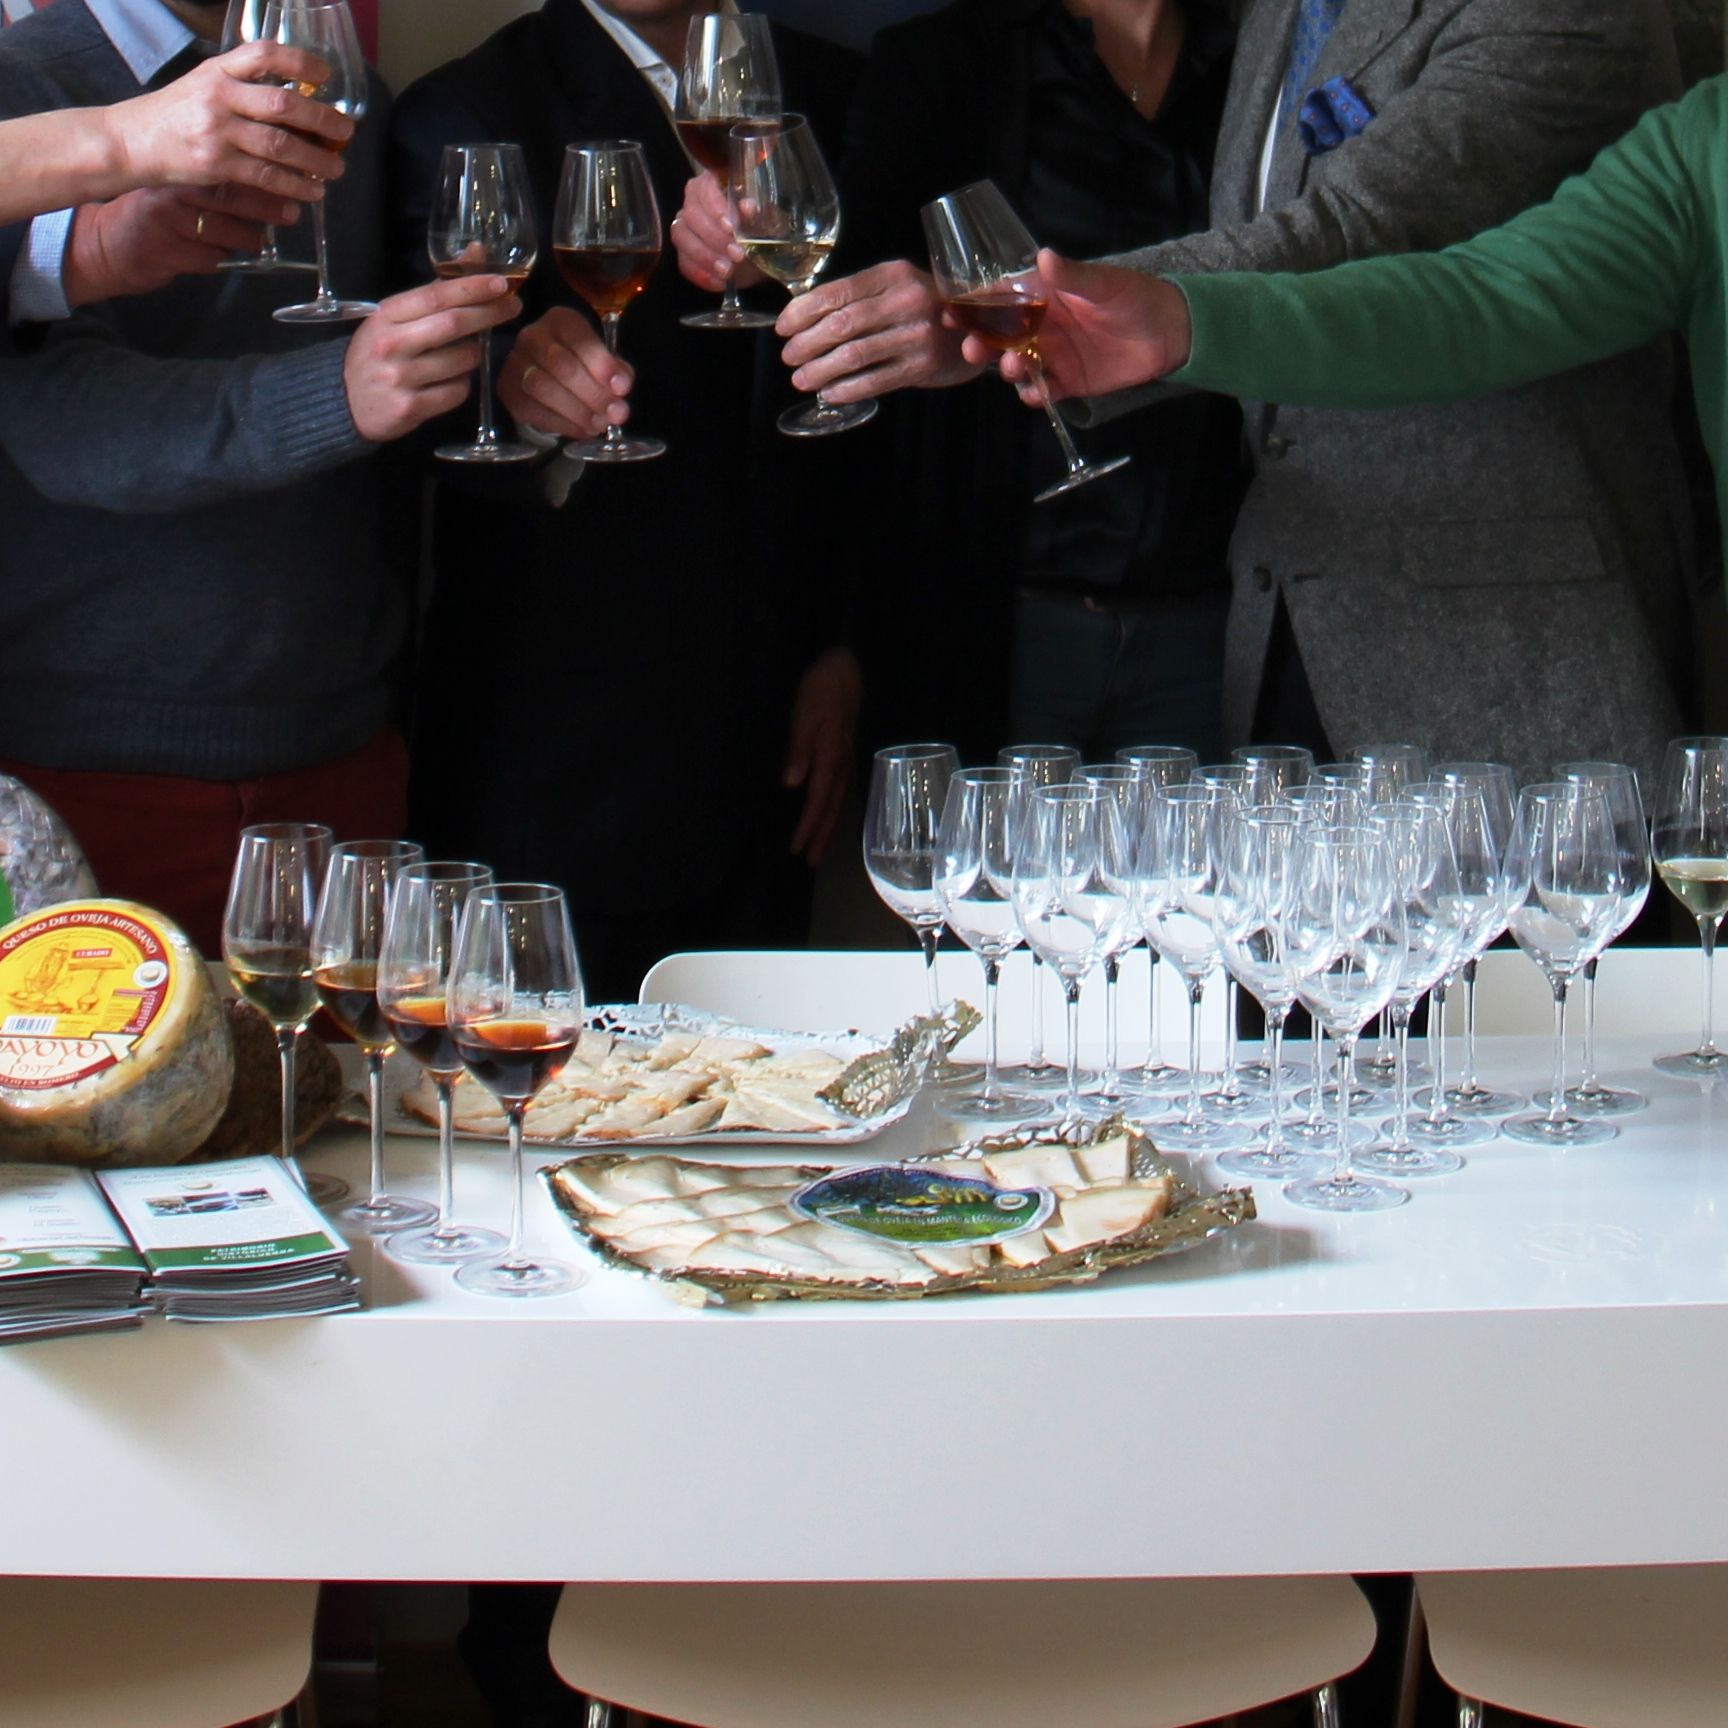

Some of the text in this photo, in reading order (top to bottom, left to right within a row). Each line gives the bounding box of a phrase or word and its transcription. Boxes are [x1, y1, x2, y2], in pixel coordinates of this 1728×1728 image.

[2, 920, 47, 950] QUESO
[48, 915, 68, 927] DE
[70, 912, 110, 925] OVEJA
[107, 915, 158, 955] ARTESANO
[8, 1063, 55, 1077] 1997
